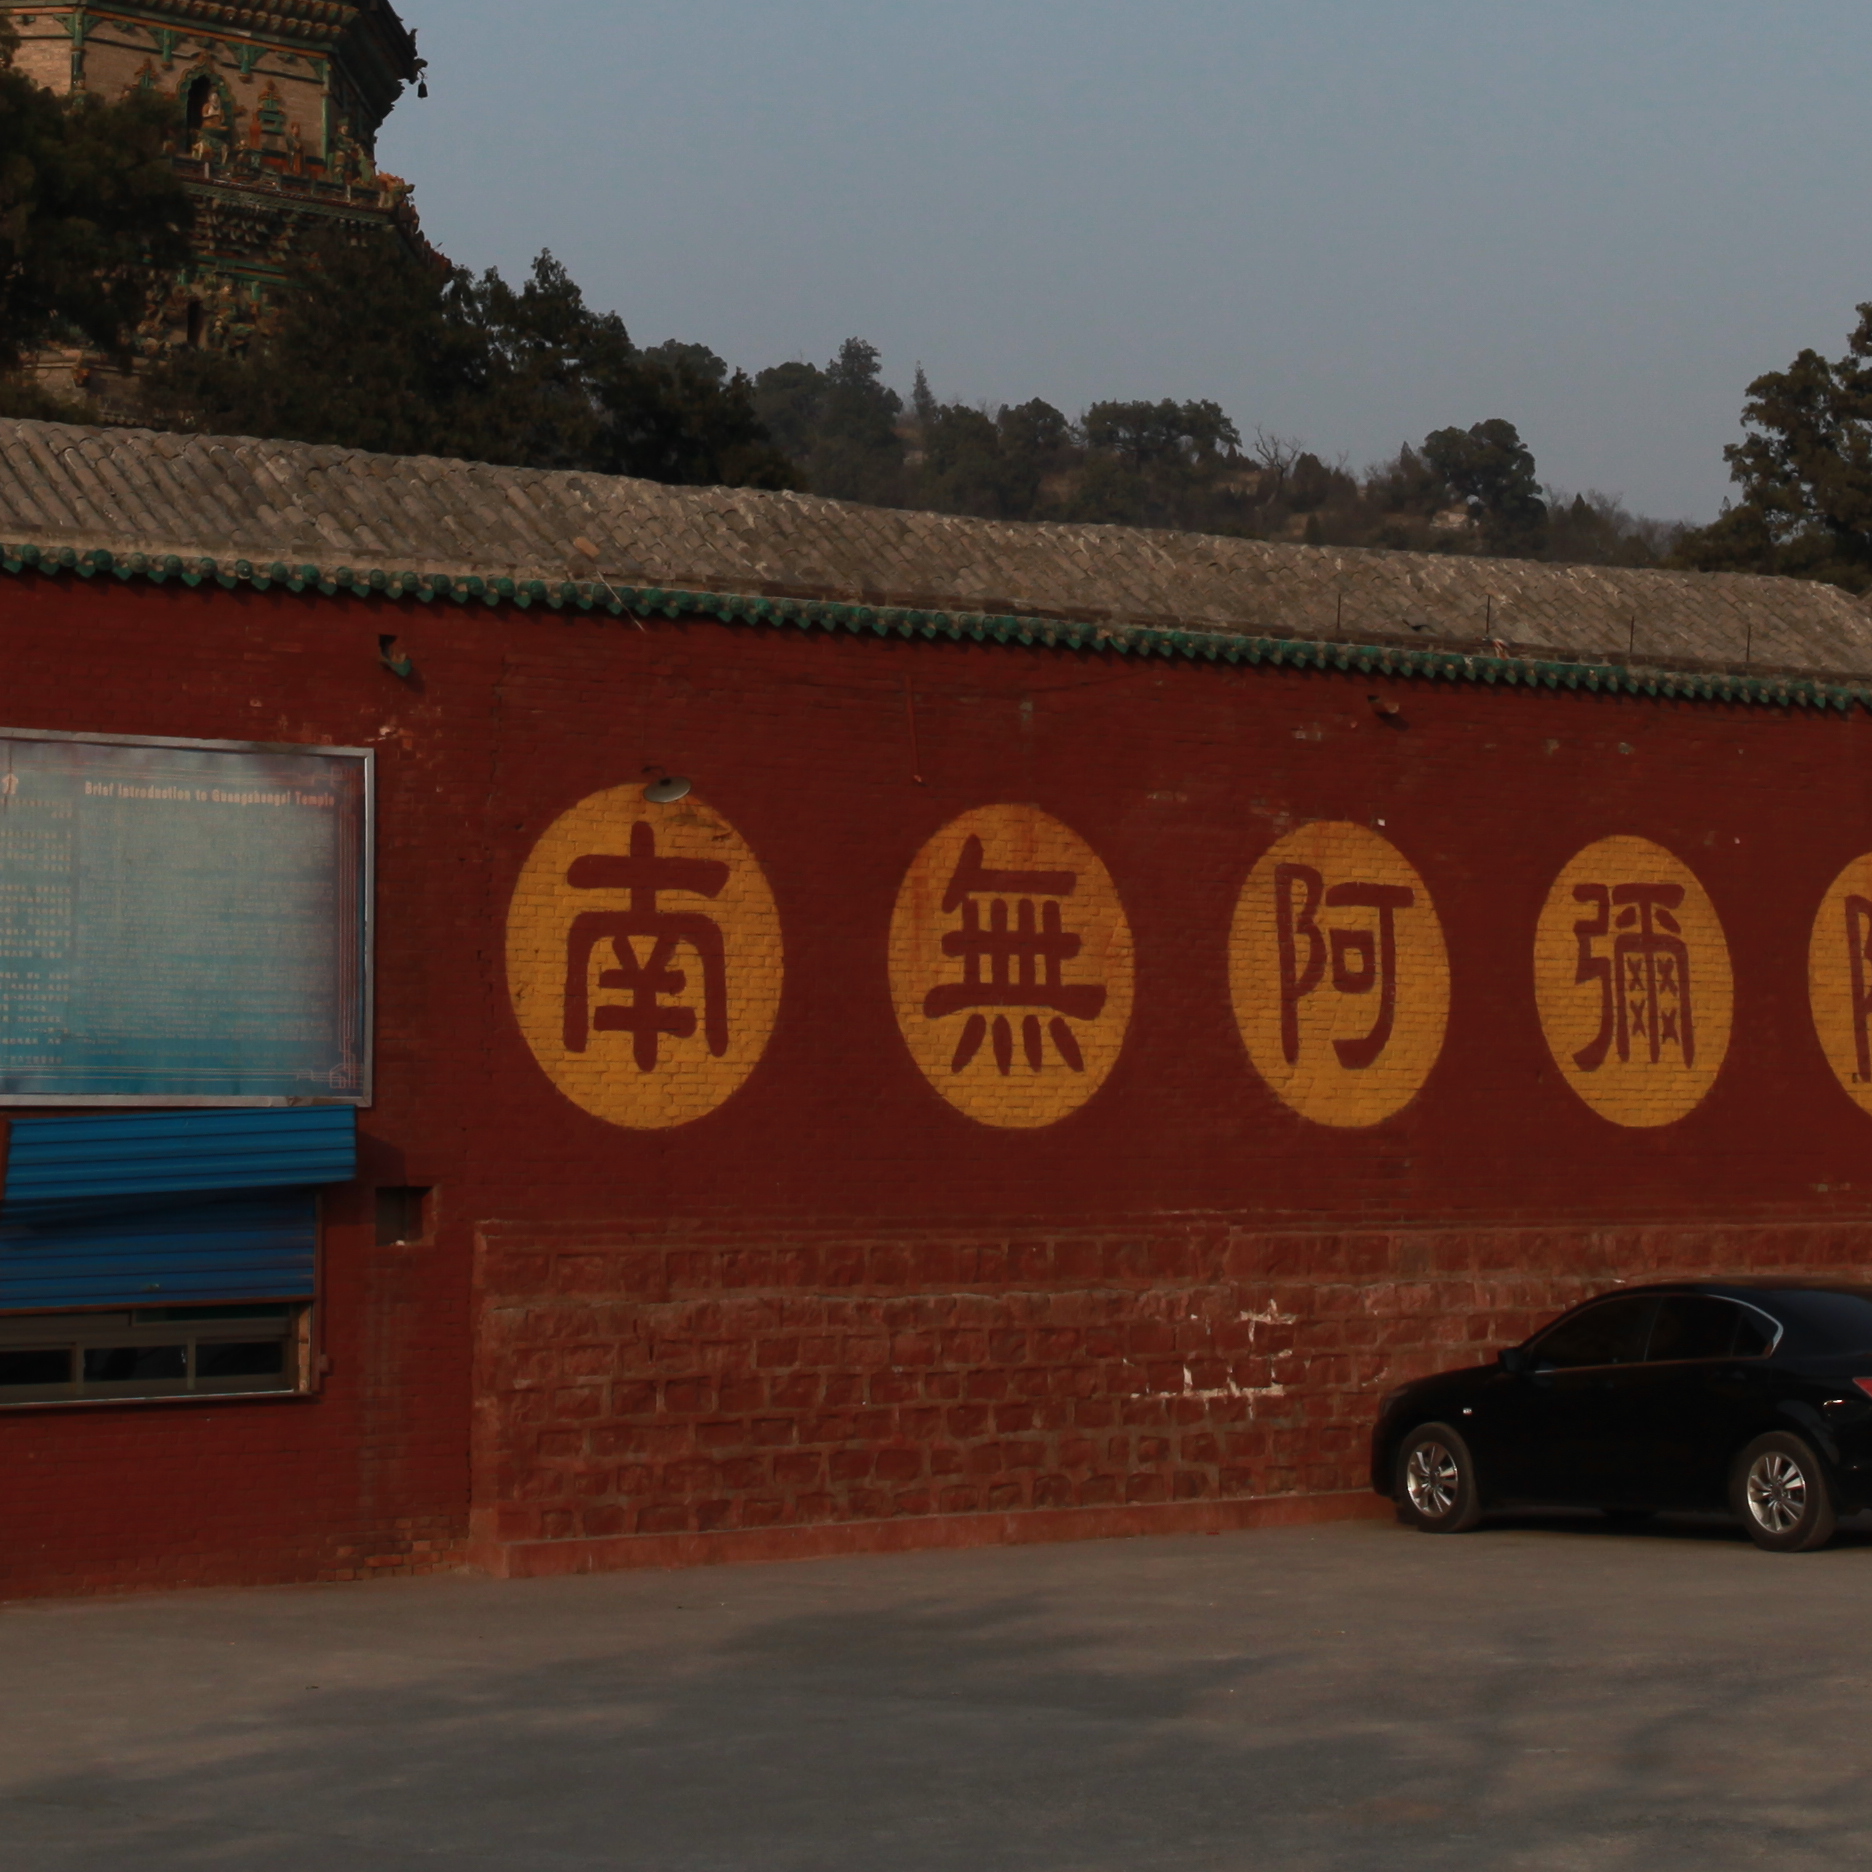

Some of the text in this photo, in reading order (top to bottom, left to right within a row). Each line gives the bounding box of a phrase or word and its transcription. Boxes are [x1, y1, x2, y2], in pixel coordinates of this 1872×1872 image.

[84, 780, 114, 797] Brief
[117, 782, 191, 802] Introduction
[195, 788, 208, 803] to
[294, 790, 335, 807] Temple
